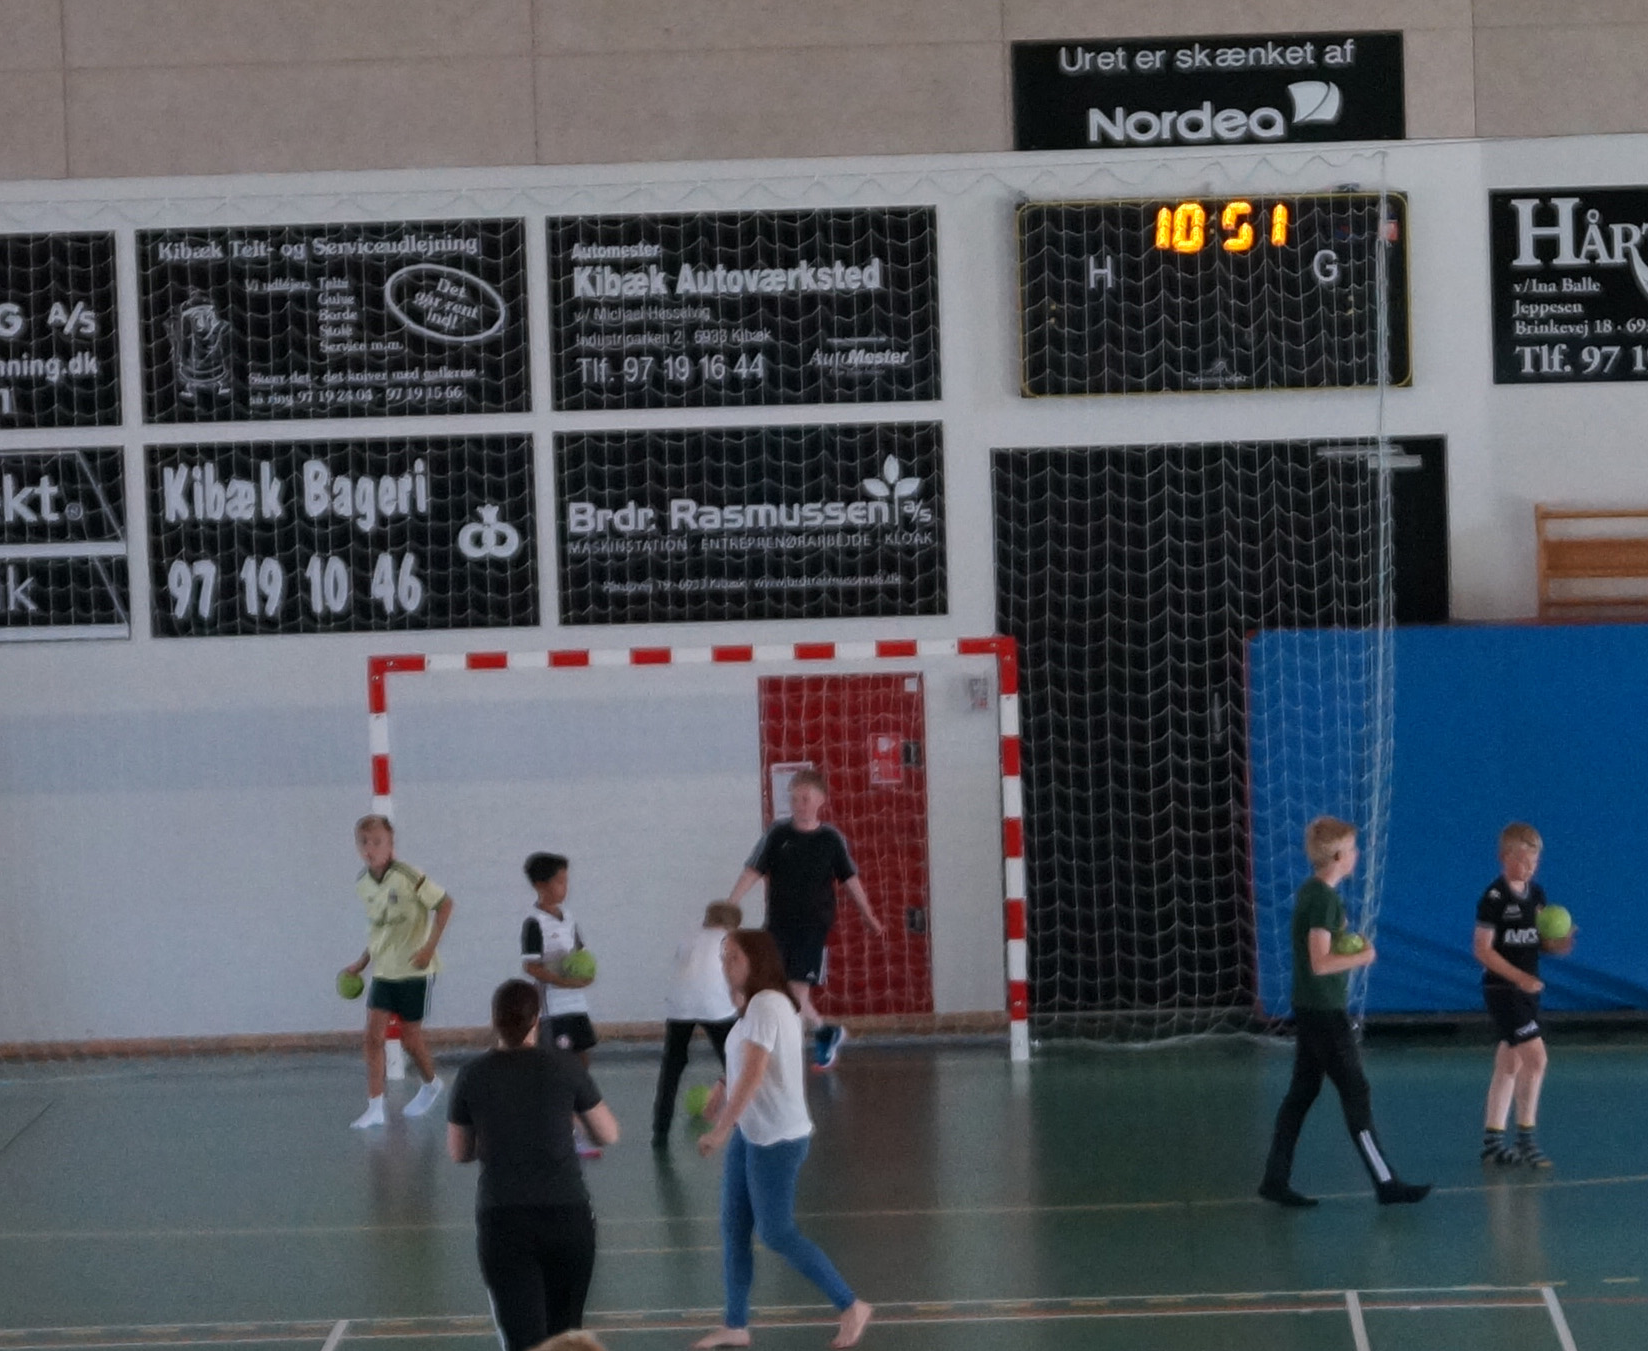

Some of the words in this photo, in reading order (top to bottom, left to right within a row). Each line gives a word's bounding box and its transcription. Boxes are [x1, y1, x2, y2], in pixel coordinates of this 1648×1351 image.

[1060, 46, 1126, 73] Uret
[1135, 49, 1166, 68] er
[1176, 42, 1316, 67] skænket
[1324, 39, 1355, 64] af
[1088, 100, 1285, 142] Nordea
[157, 239, 223, 260] Kibæk
[281, 241, 308, 260] og
[313, 235, 478, 257] Serviceudlejning
[572, 242, 660, 259] Automester
[573, 263, 667, 297] Kibæk
[676, 258, 881, 294] Autoværksted
[1089, 255, 1114, 290] H
[1313, 250, 1339, 284] G
[435, 279, 467, 298] Det
[1562, 278, 1600, 293] Balle
[47, 301, 96, 335] A/S
[1513, 300, 1583, 318] Jeppesen
[1514, 320, 1588, 337] Brinkevej
[1594, 320, 1612, 333] 18
[579, 358, 615, 383] Tlf.
[624, 356, 653, 381] 97
[665, 356, 690, 379] 19
[701, 354, 725, 379] 16
[734, 353, 763, 378] 44
[1515, 344, 1571, 373] Tlf.
[1581, 345, 1621, 372] 97
[298, 391, 315, 403] 97
[319, 390, 336, 402] 19
[386, 387, 403, 400] 97
[407, 387, 422, 399] 19
[163, 461, 283, 522] Kibæk
[303, 457, 427, 533] Bageri
[568, 501, 656, 532] Brdr.
[670, 499, 889, 530] Rasmussen
[885, 532, 932, 544] KLOAK
[167, 559, 216, 619] 97
[241, 556, 283, 617] 19
[305, 555, 348, 613] 10
[372, 552, 422, 613] 46
